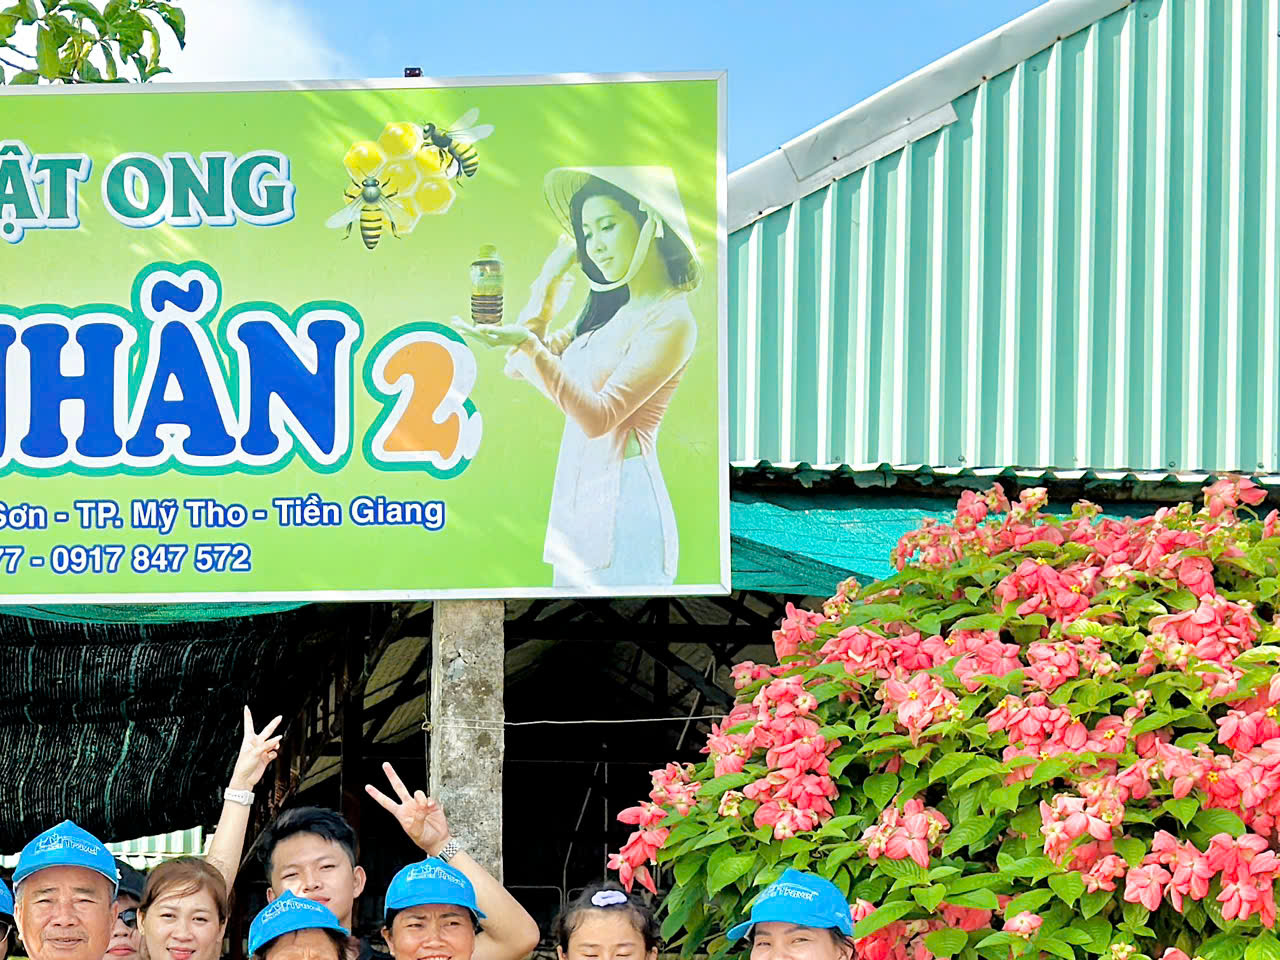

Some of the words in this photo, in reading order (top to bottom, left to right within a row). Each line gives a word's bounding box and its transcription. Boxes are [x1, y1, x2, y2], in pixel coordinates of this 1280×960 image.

[102, 149, 296, 228] ONG
[370, 329, 478, 472] 2
[74, 500, 124, 529] TP.
[131, 499, 178, 535] Mỹ
[185, 498, 247, 528] Tho
[272, 492, 342, 527] Tiền
[350, 497, 446, 531] Giang
[51, 545, 125, 573] 0917
[131, 545, 188, 573] 847
[194, 544, 251, 572] 572
